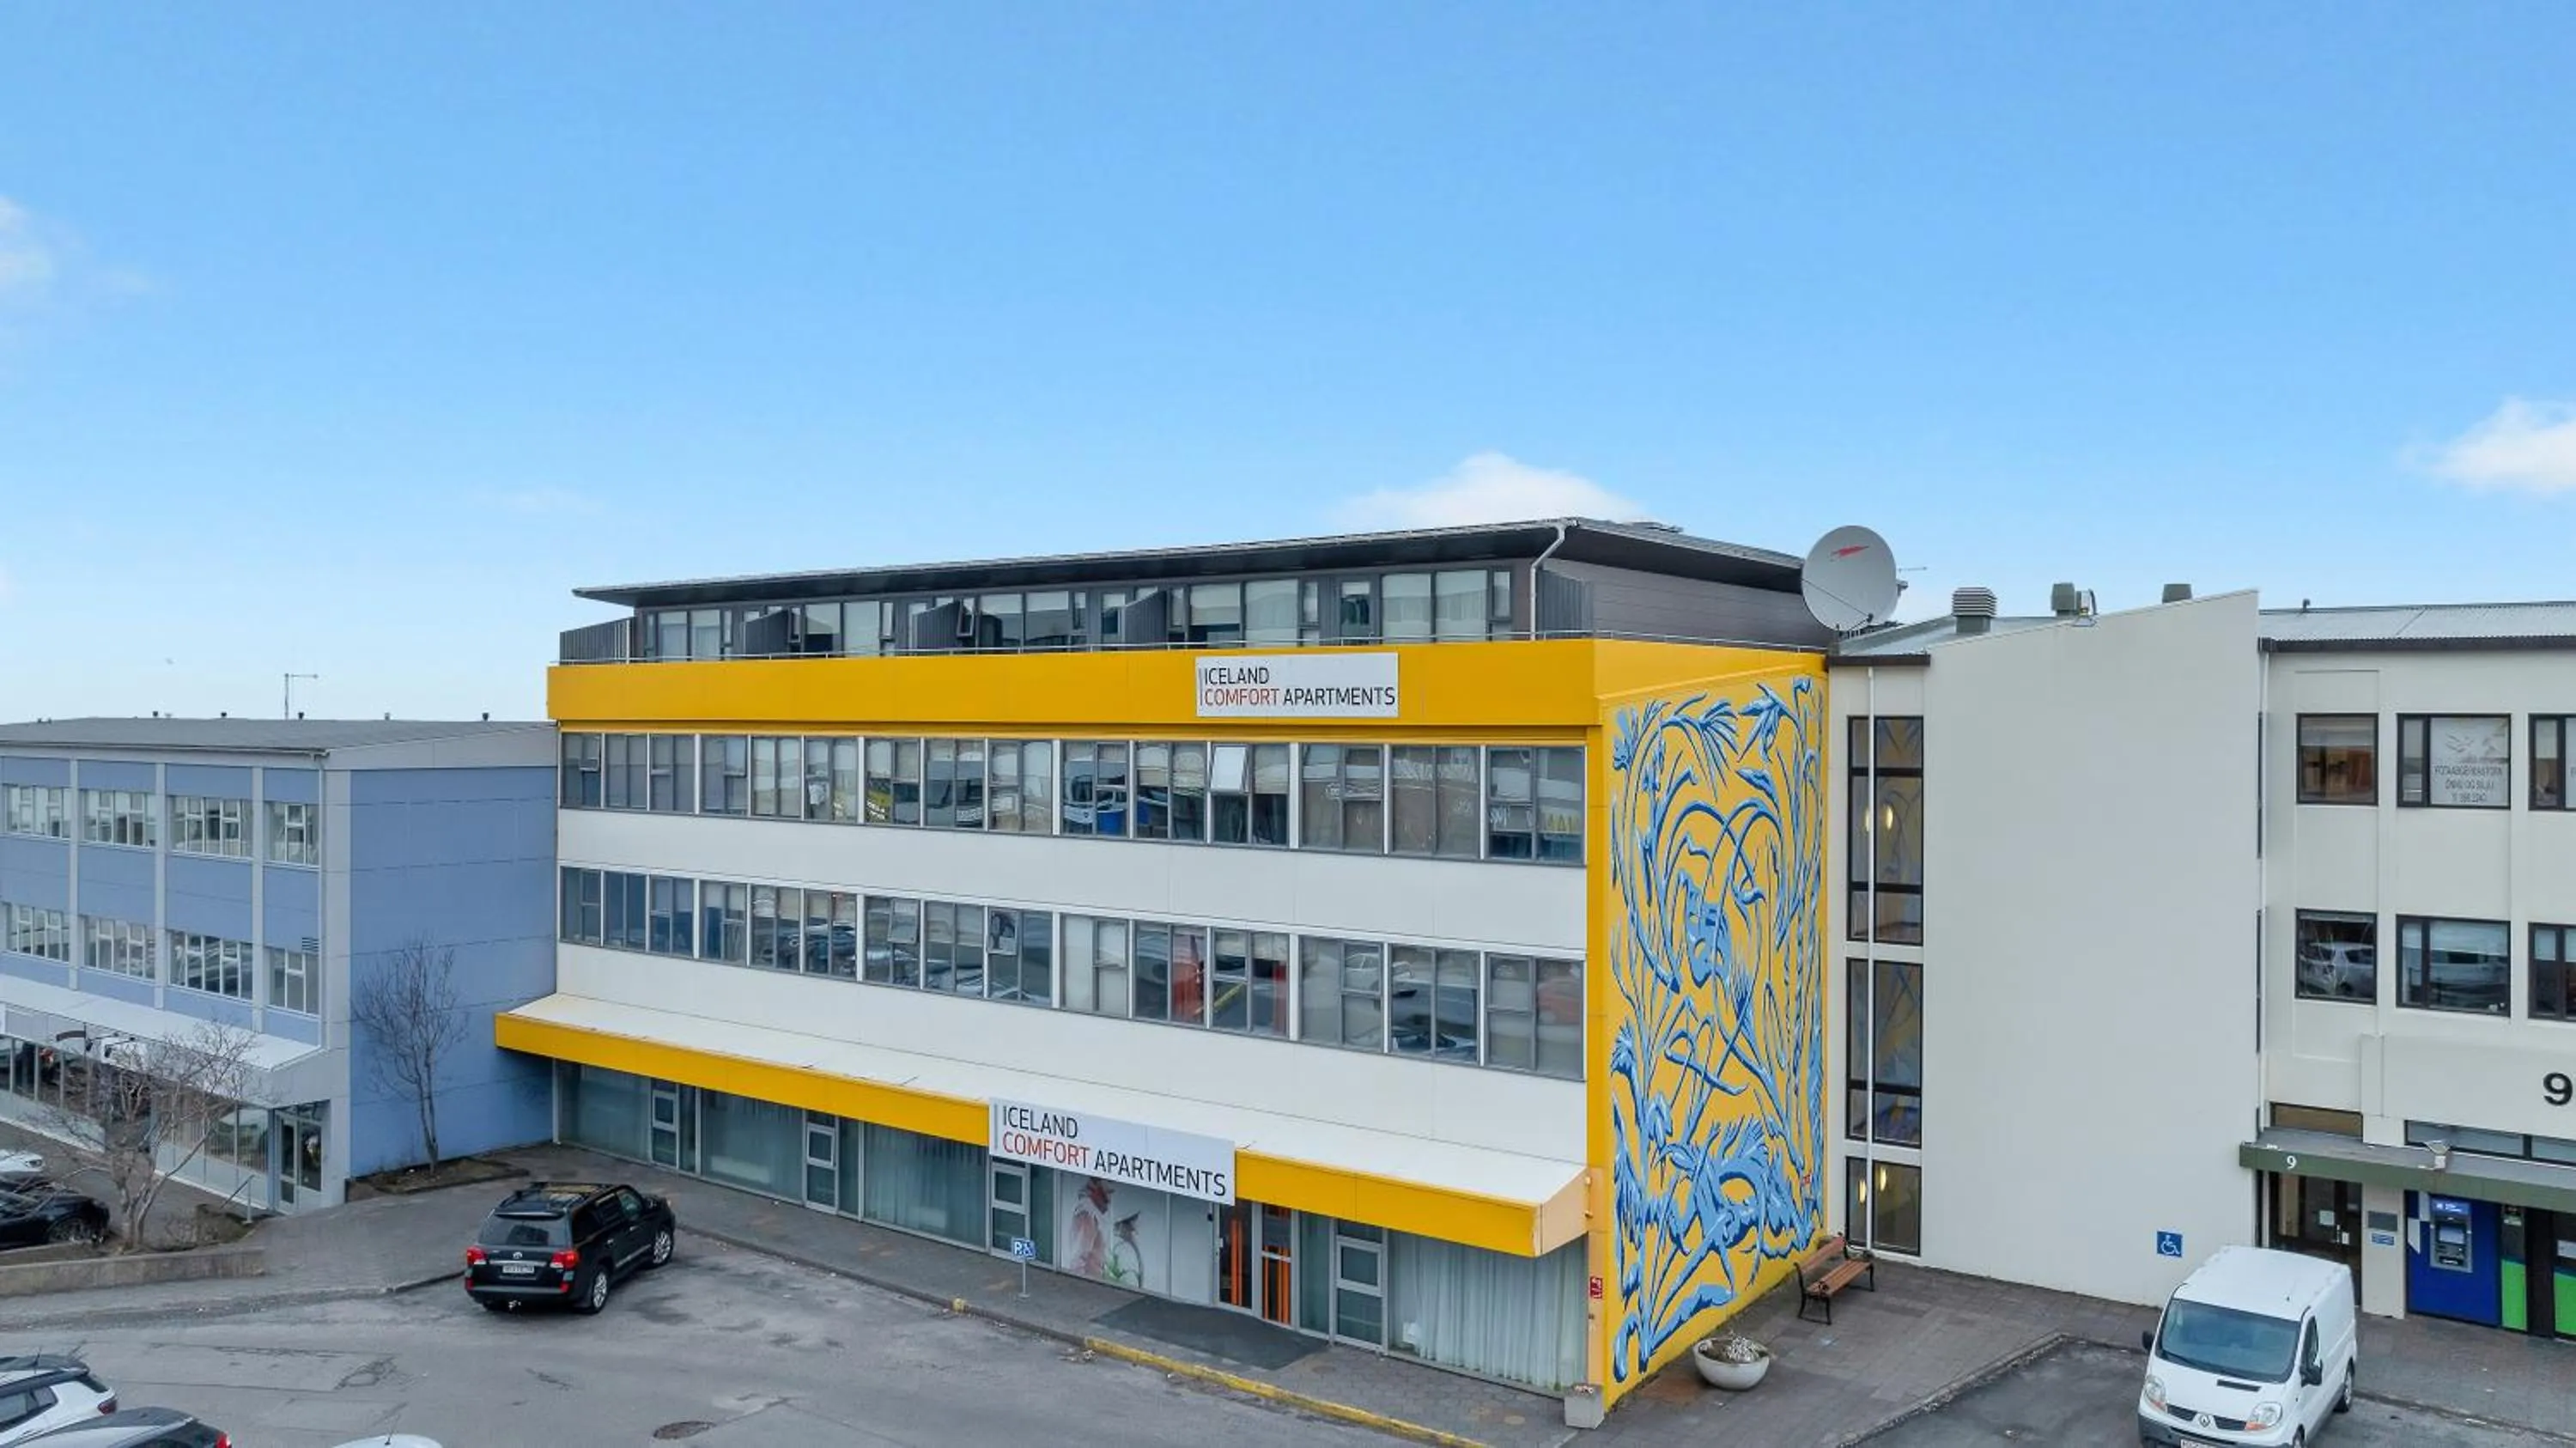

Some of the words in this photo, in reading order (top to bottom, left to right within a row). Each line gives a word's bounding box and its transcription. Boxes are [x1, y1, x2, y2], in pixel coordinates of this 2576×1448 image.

[1205, 667, 1269, 684] ICELAND
[1205, 688, 1280, 707] COMFORT
[1283, 687, 1395, 706] APARTMENTS
[2543, 1073, 2573, 1106] 9
[1003, 1105, 1078, 1138] ICELAND
[1003, 1131, 1091, 1168] COMFORT
[1094, 1150, 1226, 1196] APARTMENTS
[2287, 1155, 2297, 1169] 9
